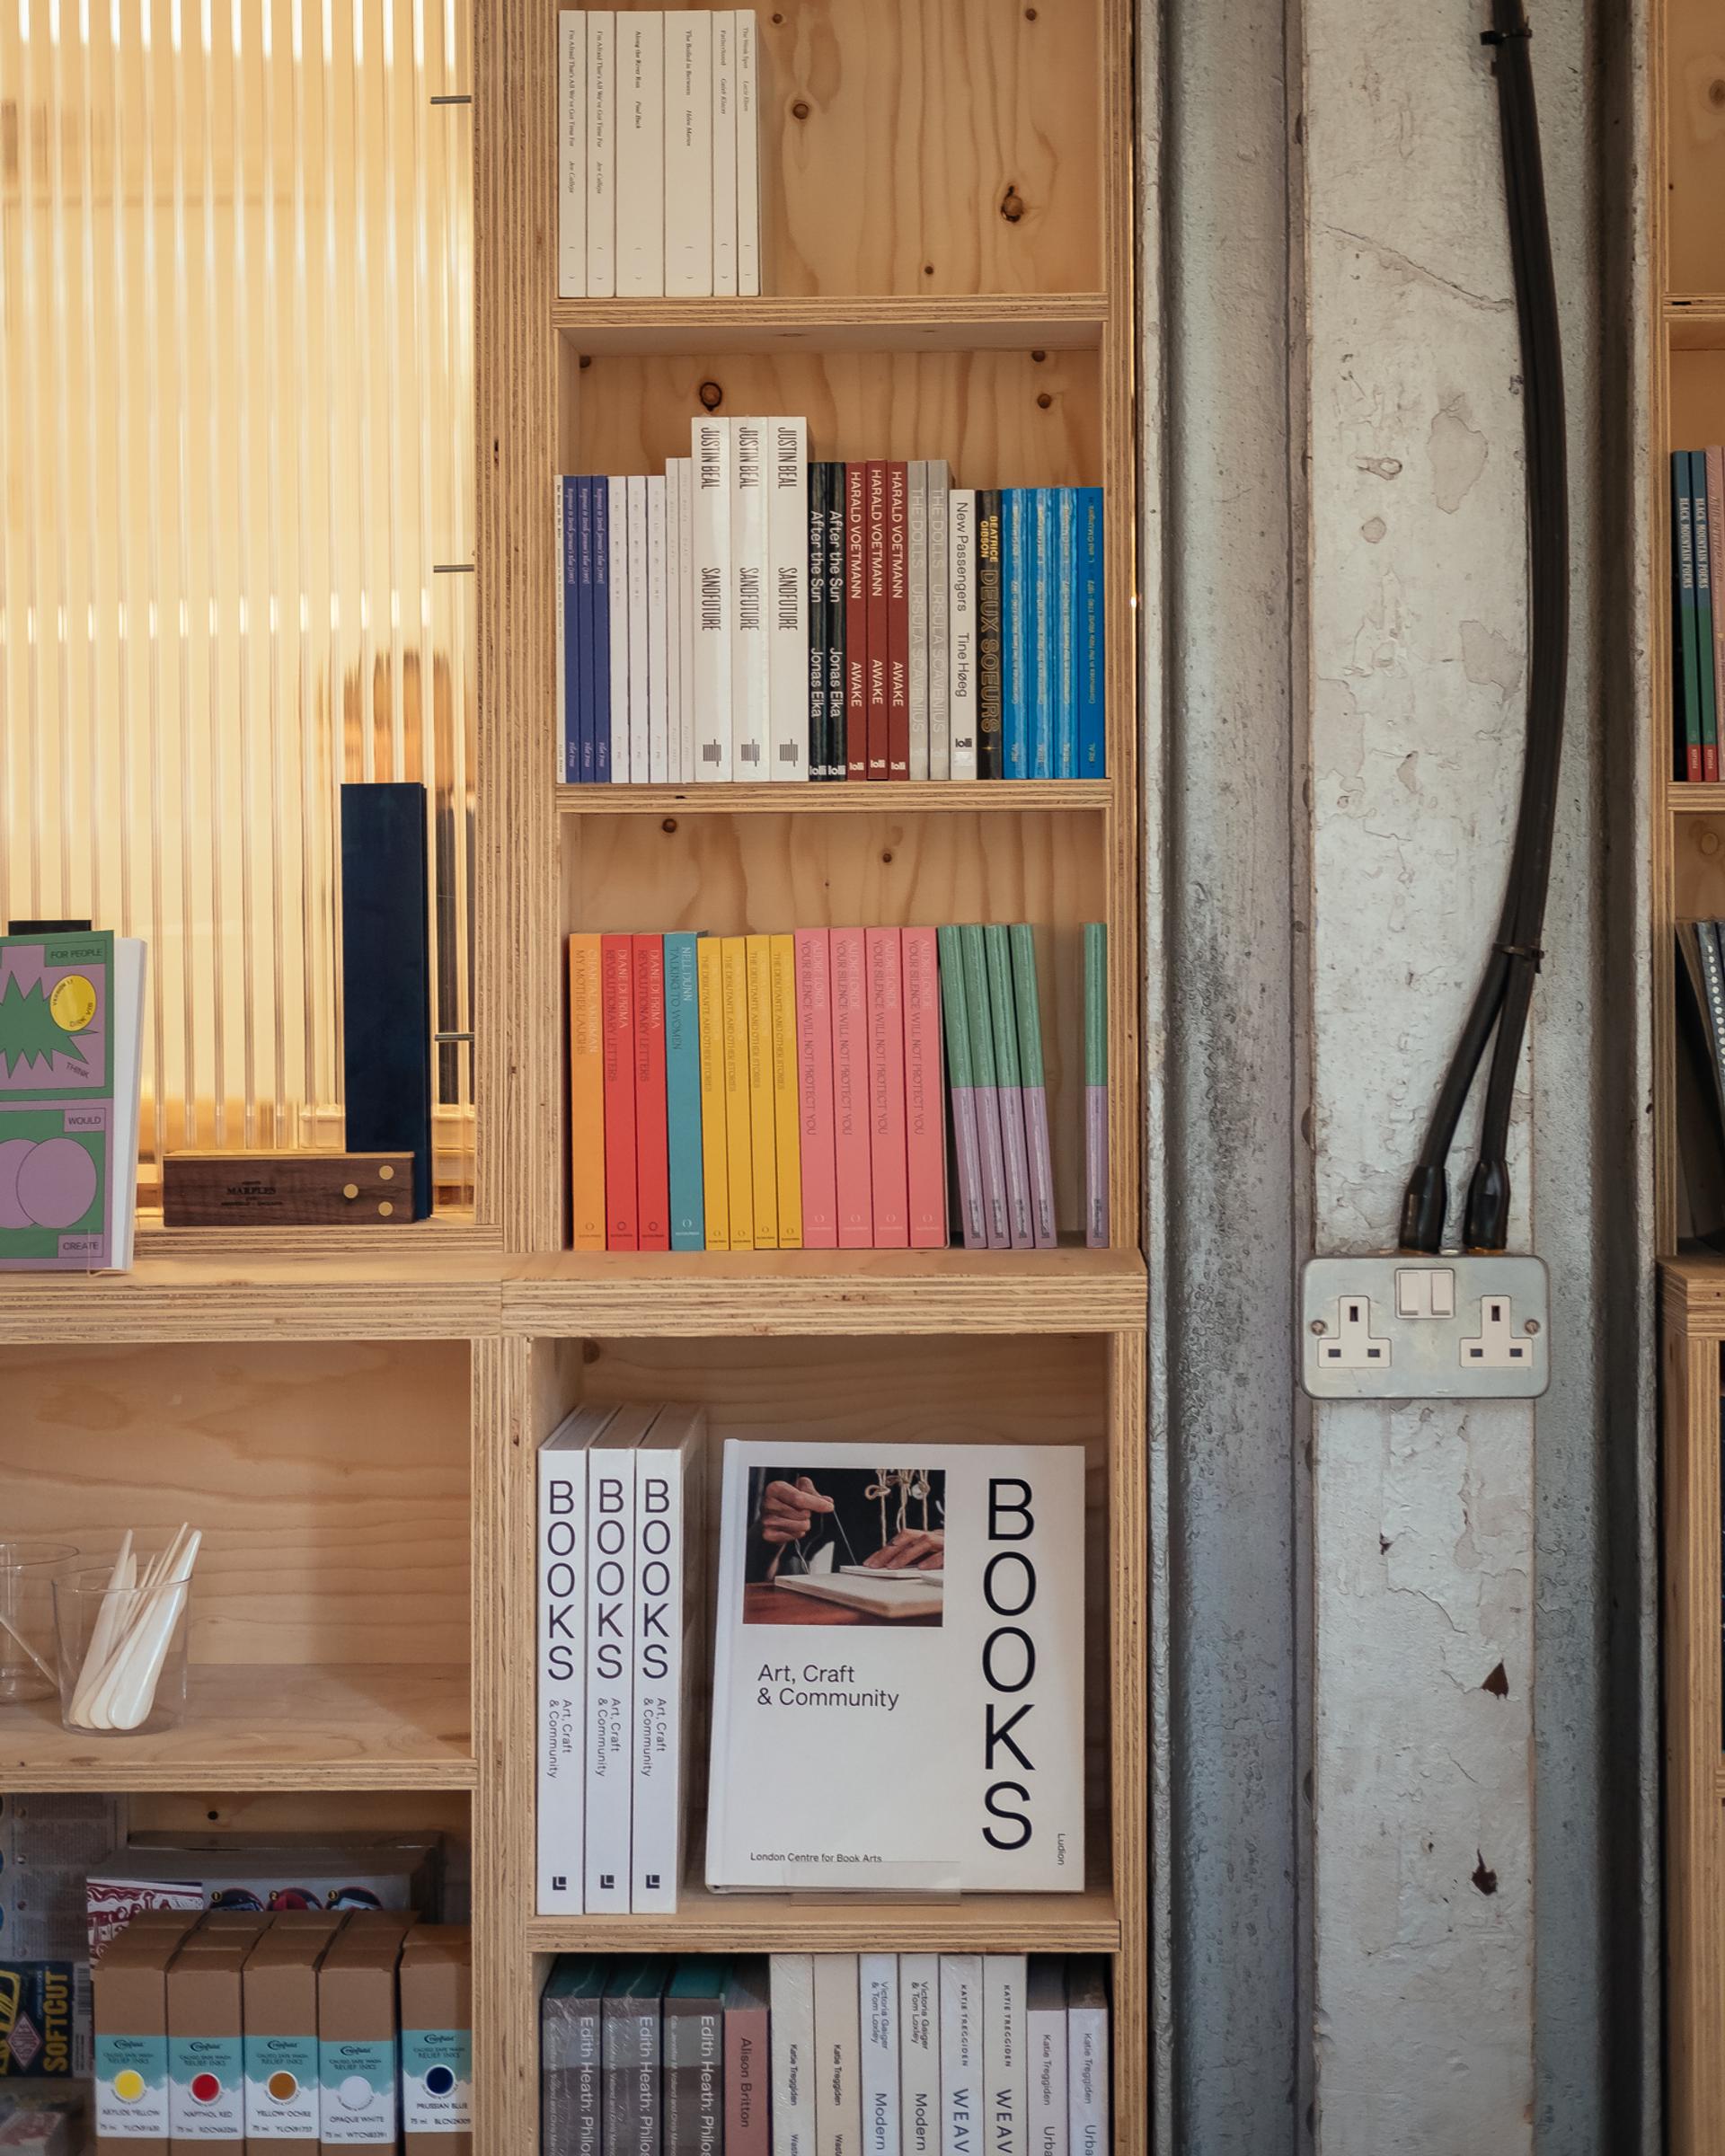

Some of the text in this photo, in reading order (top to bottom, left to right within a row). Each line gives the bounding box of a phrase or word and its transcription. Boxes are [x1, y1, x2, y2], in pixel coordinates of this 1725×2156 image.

[701, 427, 721, 489] JUSTIN BEAL
[739, 427, 759, 489] JUSTIN BEAL
[778, 427, 797, 489] JUSTIN BEAL
[810, 510, 824, 602] After the Sun
[829, 510, 842, 602] After the Sun
[850, 471, 862, 598] HARALD VOETMANN
[871, 470, 883, 596] HARALD VOETMANN
[891, 471, 904, 598] HARALD VOETMANN
[954, 502, 968, 612] New Passengers
[980, 521, 990, 558] GIBSON
[989, 516, 998, 561] BEATRICE
[1695, 498, 1710, 589] BLACK MOUNTAIN POEMS
[702, 568, 721, 631] SANDFUTURE
[740, 568, 760, 631] SANDFUTURE
[778, 568, 798, 631] SANDFUTURE
[811, 648, 824, 717] Jonas Eika
[829, 648, 842, 717] Jonas Eika
[871, 659, 883, 704] AWAKE
[955, 632, 969, 697] Tine Høeg
[981, 570, 999, 733] DEUX SOEURS
[851, 661, 862, 707] AWAKE
[892, 661, 904, 707] AWAKE
[50, 949, 102, 959] FOR PEOPLE
[588, 950, 597, 996] CHANTAL
[681, 947, 693, 1001] NELL DUNN
[576, 950, 586, 1055] MY MOTHER LAUGHS
[606, 950, 617, 1082] REVOLUTIONARY LETTERS
[618, 950, 628, 1028] DIANE DI PRIMA
[668, 947, 681, 1050] TALKING TO WOMEN
[908, 940, 924, 1135] YOUR SILENCE WILL NOT PROTECT YOU
[66, 1062, 90, 1078] THINK
[68, 1117, 102, 1125] WOULD
[63, 1242, 99, 1250] CREATE
[547, 1480, 575, 1681] BOOKS
[597, 1479, 624, 1680] BOOKS
[642, 1479, 670, 1680] BOOKS
[757, 1664, 854, 1683] Art, Craft
[982, 1478, 1037, 1851] BOOKS
[561, 1700, 573, 1754] Art, Craft
[609, 1698, 622, 1752] Art, Craft
[654, 1698, 668, 1752] Art, Craft
[757, 1688, 899, 1710] & Community
[547, 1700, 559, 1778] & Community
[595, 1698, 607, 1777] & Community
[641, 1698, 654, 1777] & Community
[750, 1851, 882, 1863] London Centre for Book Arts
[1057, 1833, 1066, 1866] Ludion
[43, 1971, 68, 2072] SOFTCUT
[871, 2013, 880, 2044] Loxley
[880, 1982, 889, 2049] Victoria Gaiger
[911, 2014, 920, 2044] Loxley
[912, 1993, 920, 2011] Tom
[580, 2017, 593, 2057] Edith
[640, 2017, 653, 2057] Edith
[701, 2017, 714, 2057] Edith
[920, 2019, 930, 2049] Gaiger
[580, 2062, 593, 2111] Heath:
[640, 2062, 653, 2111] Heath:
[701, 2062, 714, 2111] Heath:
[740, 2037, 751, 2127] Alison Britton
[790, 2067, 798, 2106] Treggiden
[833, 2044, 842, 2106] Katie Treggiden
[1042, 2034, 1052, 2105] Katie Treggiden
[1084, 2033, 1092, 2104] Katie Treggiden
[875, 2093, 888, 2150] Modern
[915, 2093, 928, 2151] Modern
